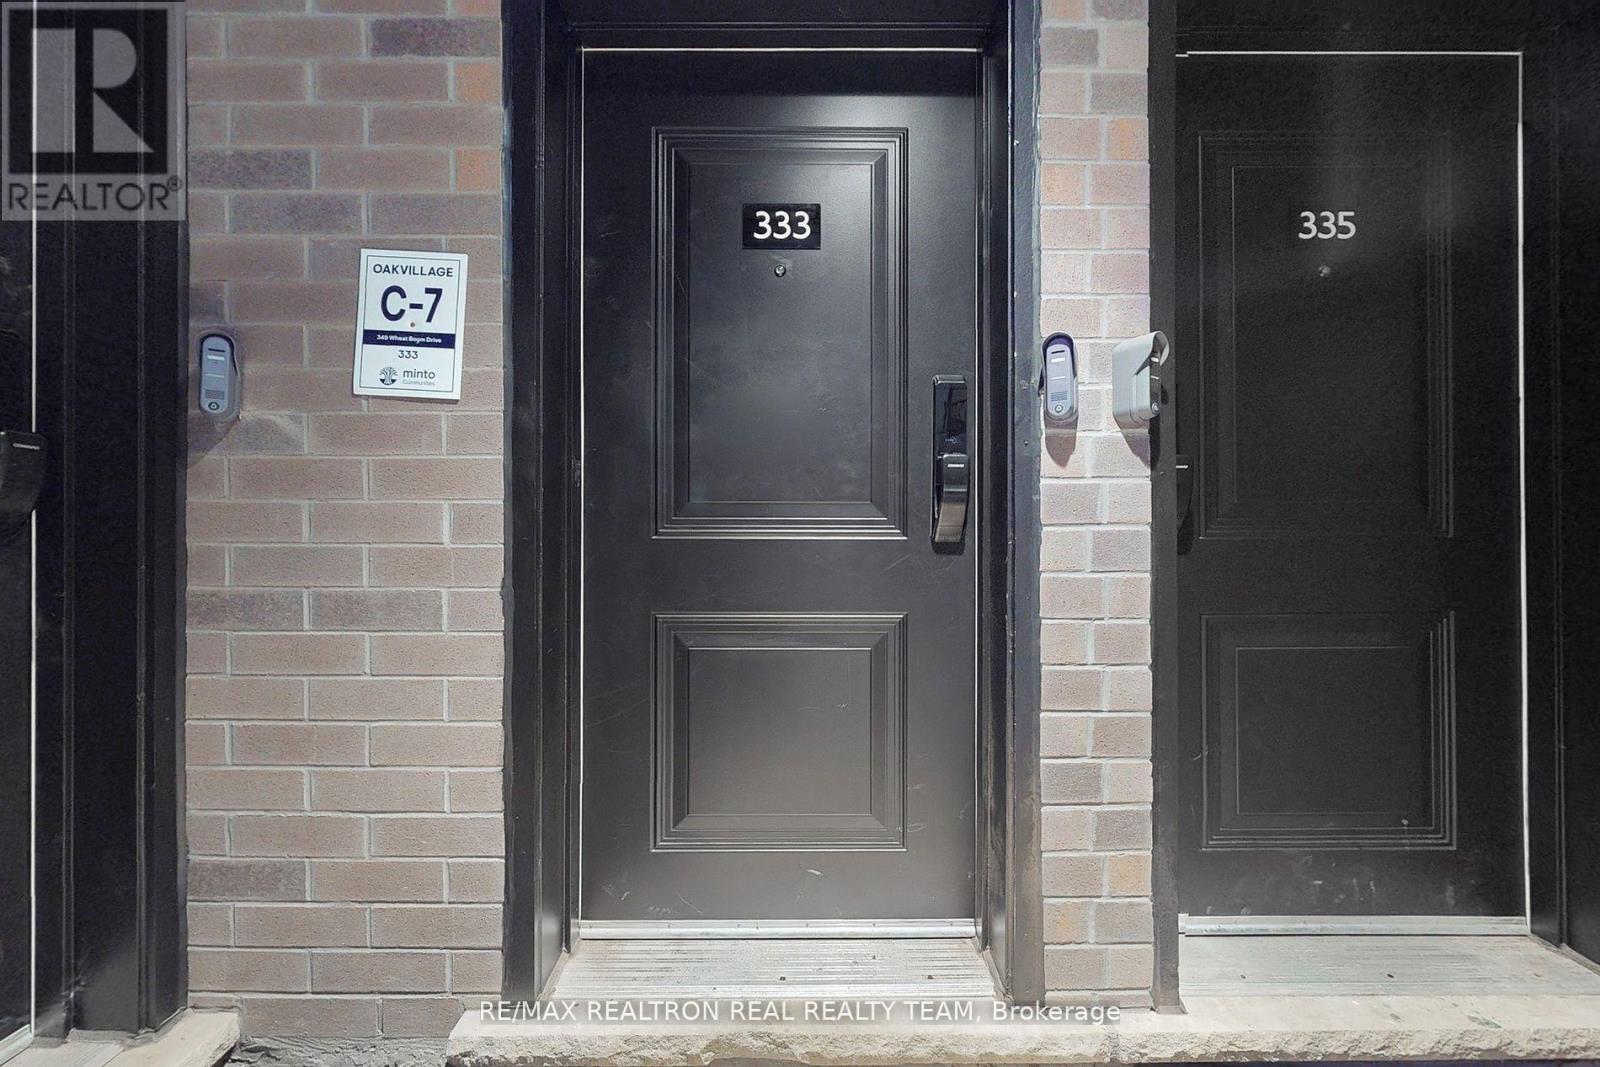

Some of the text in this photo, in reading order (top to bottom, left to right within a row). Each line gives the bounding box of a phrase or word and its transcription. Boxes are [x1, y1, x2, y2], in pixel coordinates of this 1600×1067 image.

[753, 210, 811, 240] 333
[1298, 210, 1357, 240] 335
[372, 263, 454, 278] OAKVILLAGE
[380, 284, 443, 323] C-7
[398, 349, 419, 360] 333
[402, 368, 436, 380] minto
